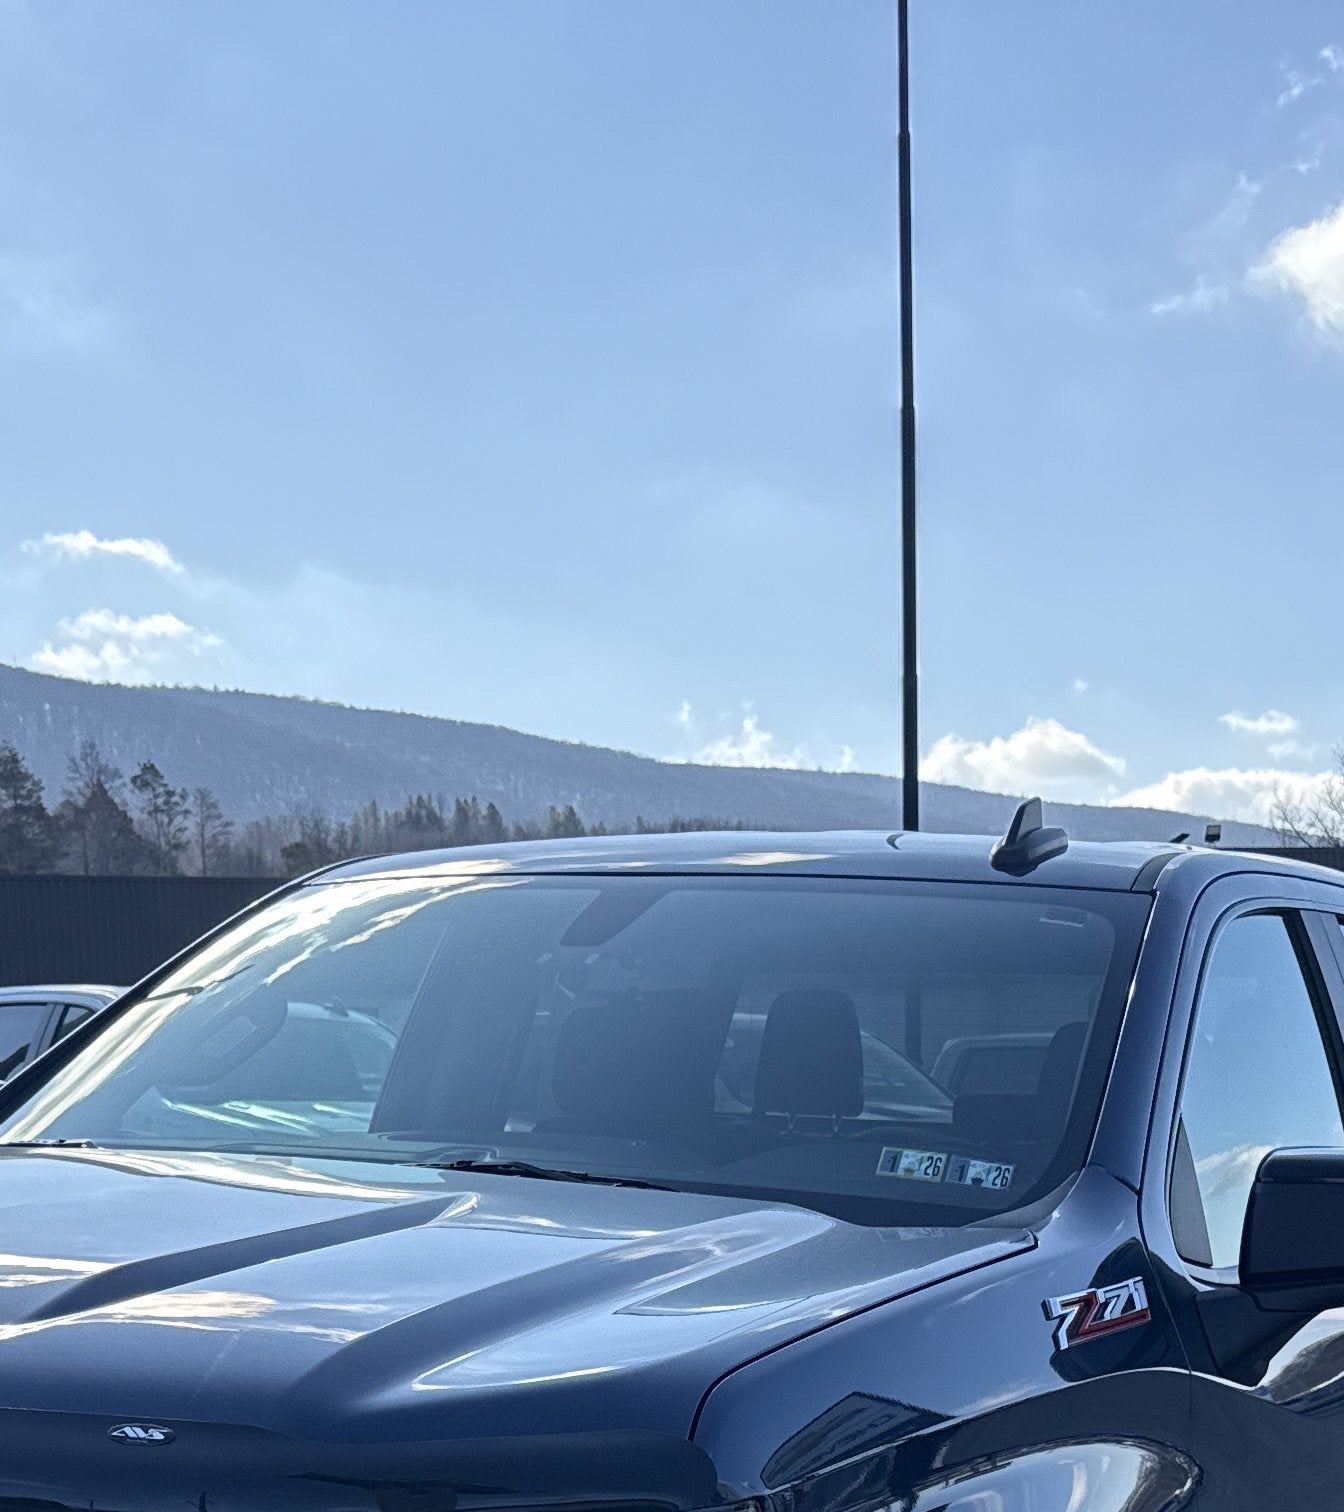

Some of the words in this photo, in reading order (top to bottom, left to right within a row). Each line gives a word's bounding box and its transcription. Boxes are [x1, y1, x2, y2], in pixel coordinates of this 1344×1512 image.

[889, 1155, 898, 1172] 1
[923, 1157, 942, 1177] 26
[957, 1164, 966, 1182] 1
[991, 1166, 1011, 1187] 26
[1041, 1276, 1151, 1350] Z71
[111, 1426, 168, 1440] AVS
